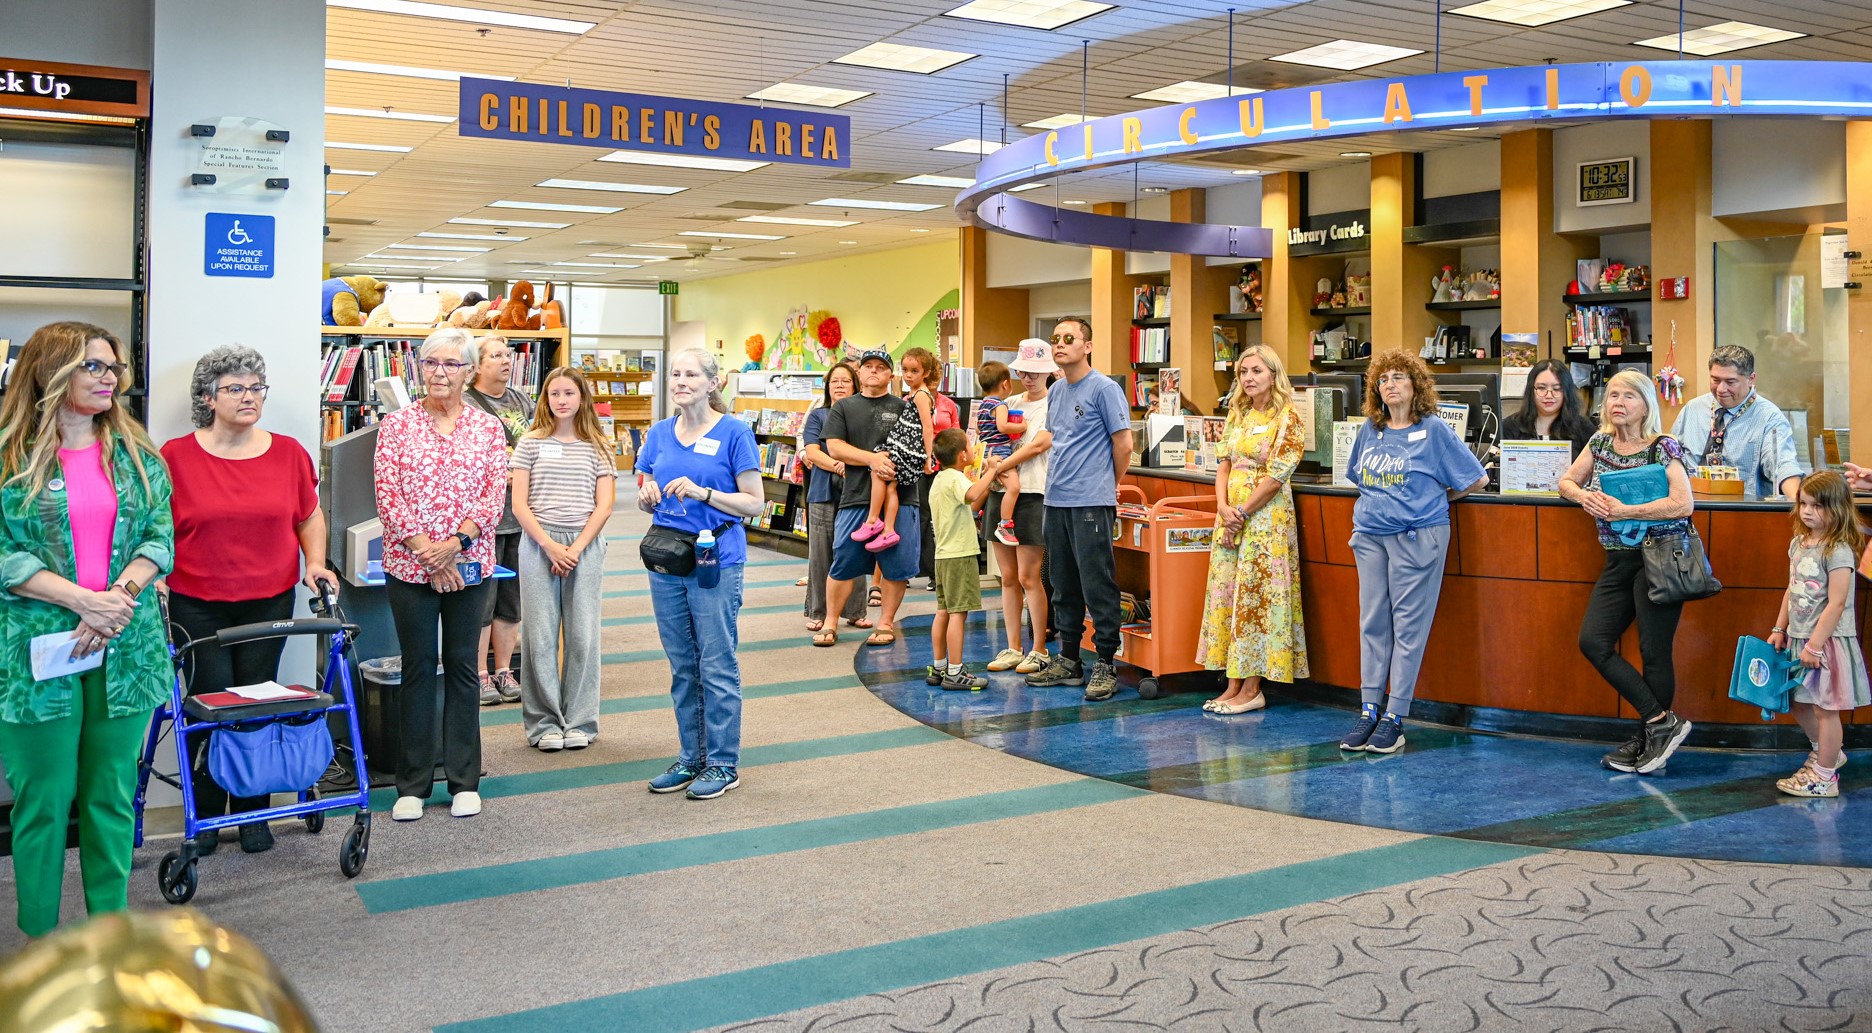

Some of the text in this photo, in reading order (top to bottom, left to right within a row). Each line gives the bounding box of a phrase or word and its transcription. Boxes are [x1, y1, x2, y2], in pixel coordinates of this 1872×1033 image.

[32, 74, 71, 99] Up
[1044, 65, 1742, 168] CIRCULATION
[479, 93, 839, 160] CHILDREN'S AREA
[1588, 165, 1619, 185] 10:32
[1287, 221, 1365, 246] Library Cards
[216, 248, 263, 257] ASSISTANCE
[219, 256, 260, 264] AVAILABLE
[234, 263, 269, 271] REQUEST
[662, 283, 677, 294] EXIT
[272, 621, 295, 629] drive
